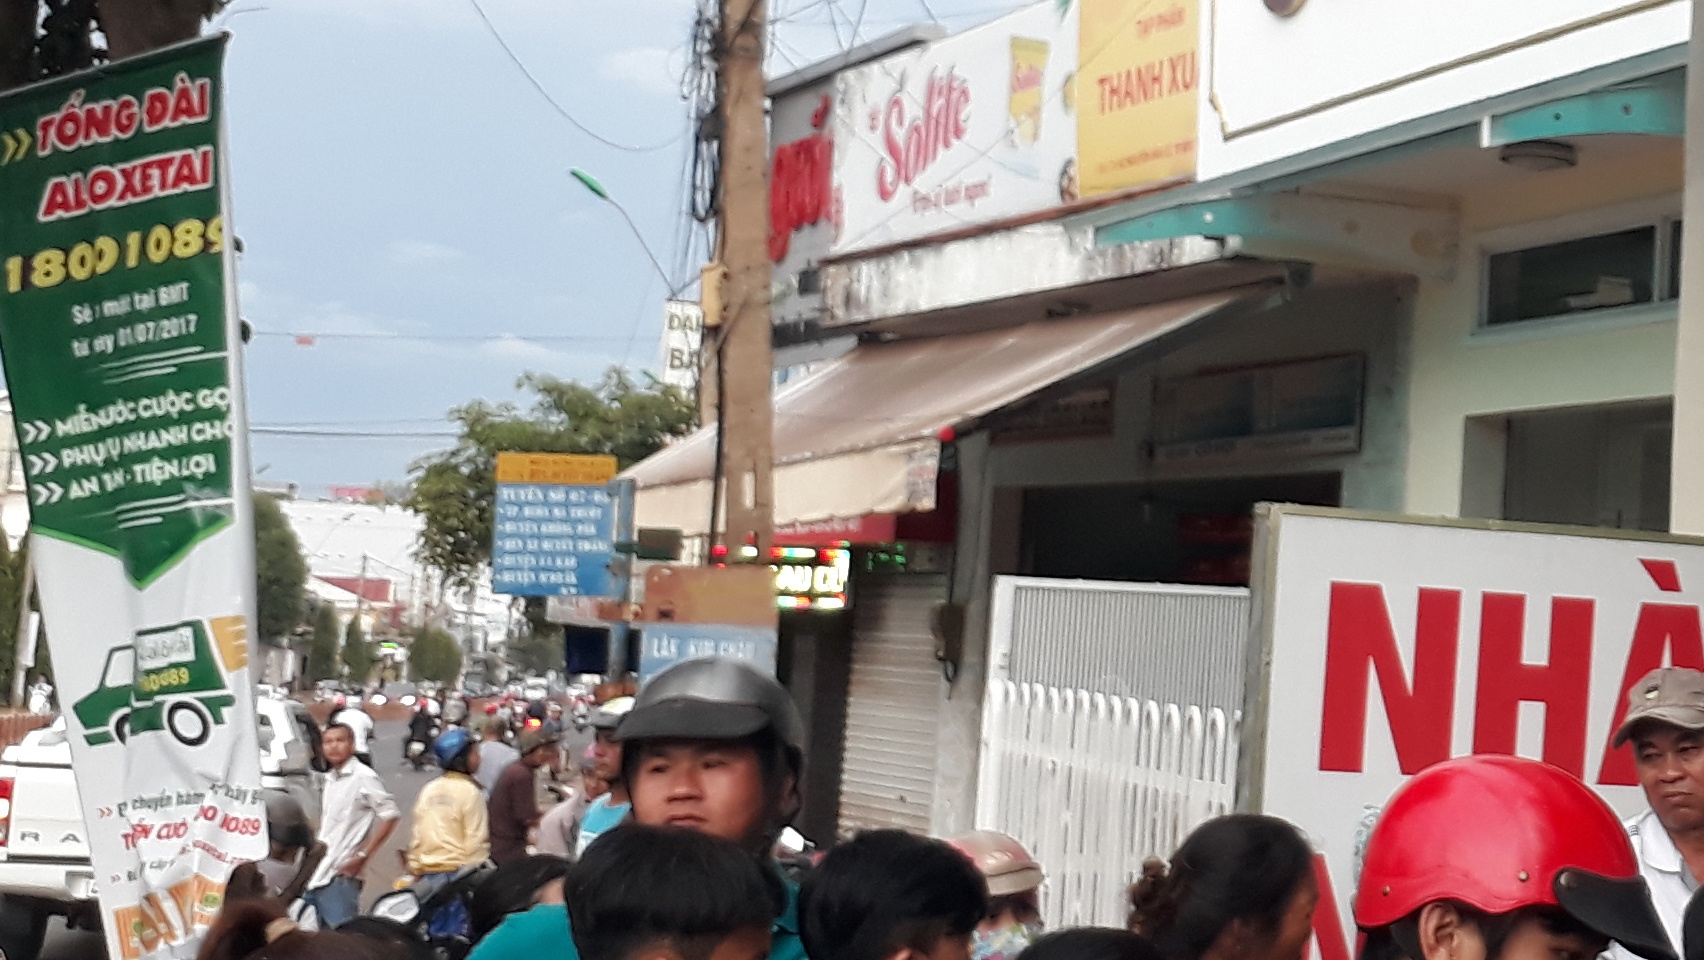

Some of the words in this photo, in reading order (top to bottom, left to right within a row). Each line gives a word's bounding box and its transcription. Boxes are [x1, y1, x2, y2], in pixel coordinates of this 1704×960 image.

[143, 71, 210, 133] ĐÀI
[1097, 58, 1165, 117] THANH
[1167, 50, 1198, 98] XU
[38, 145, 214, 222] ALOXETAI
[138, 389, 195, 419] CUỘC
[197, 387, 230, 411] GỌ
[122, 424, 188, 455] NHANH
[68, 475, 99, 500] AN
